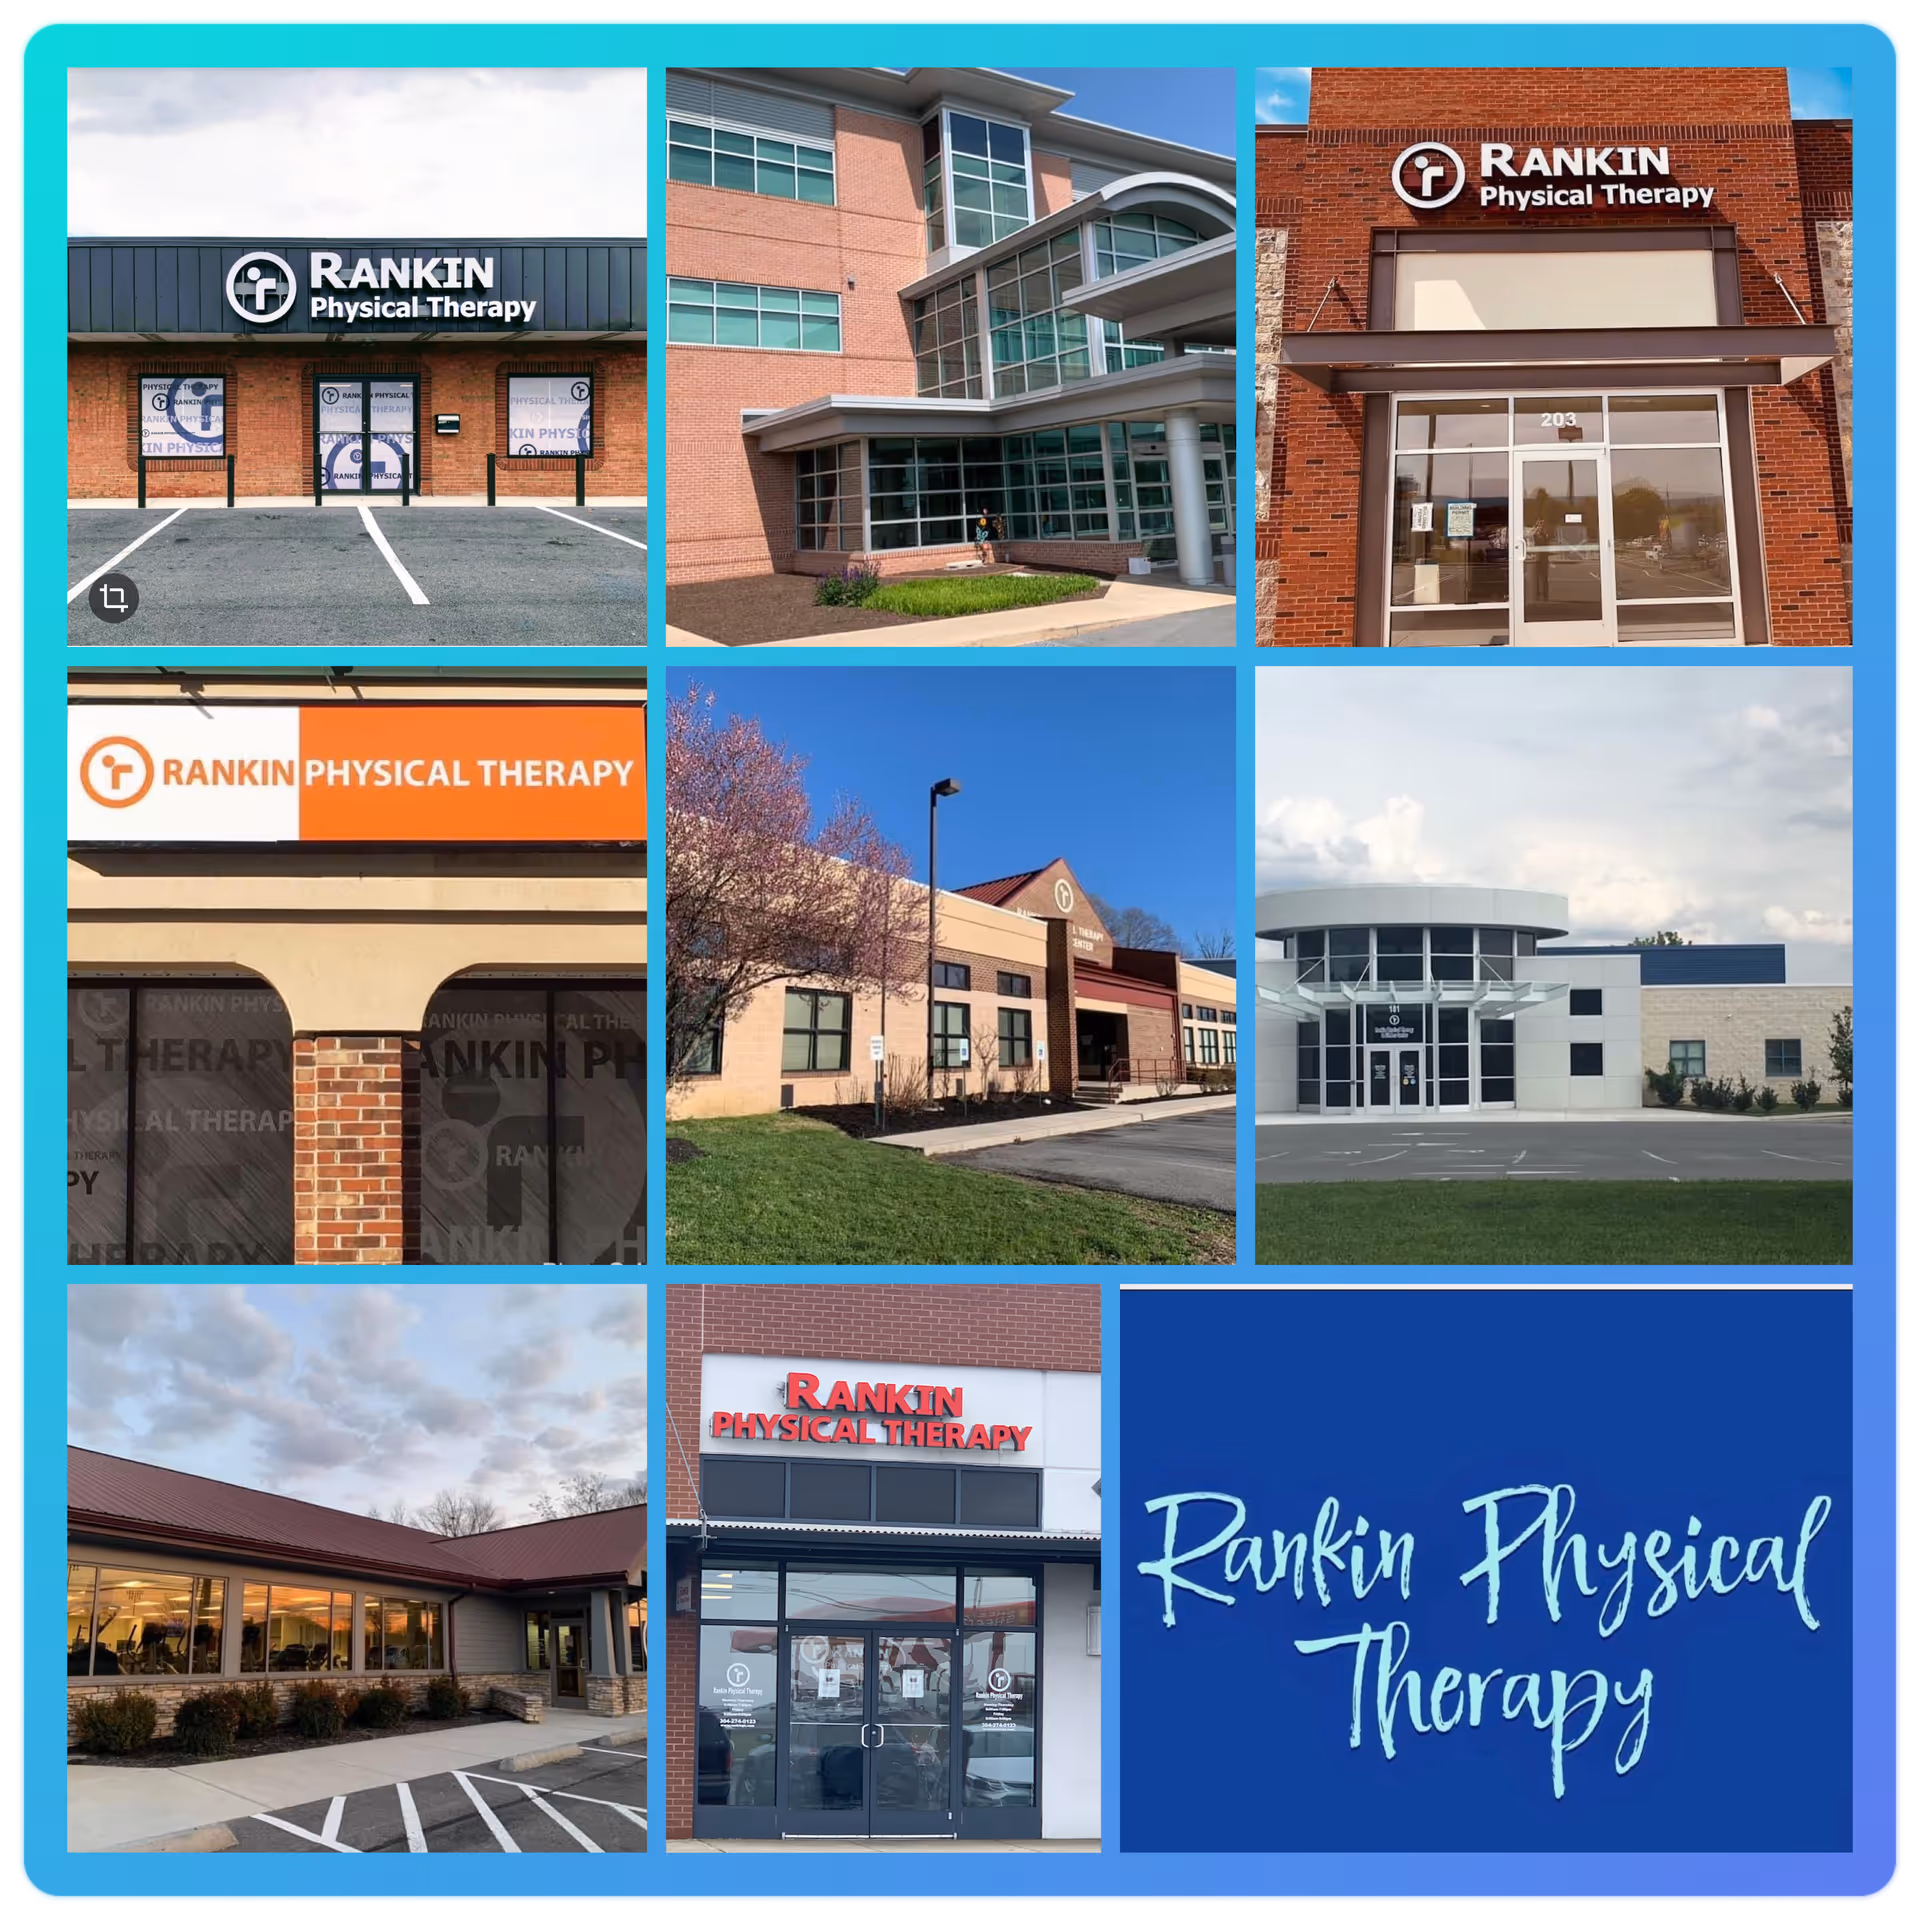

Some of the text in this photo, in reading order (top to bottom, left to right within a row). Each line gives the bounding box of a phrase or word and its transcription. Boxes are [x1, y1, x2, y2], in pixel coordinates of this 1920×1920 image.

[1481, 143, 1669, 178] RANKIN
[1481, 183, 1714, 211] Physical Therapy
[311, 251, 494, 289] RANKIN
[311, 296, 537, 323] Physical Therapy
[1541, 412, 1577, 426] 203
[162, 758, 635, 787] RANKIN PHYSICAL THERAPY
[787, 1371, 964, 1418] RANKIN
[711, 1411, 1033, 1451] PHYSICAL THERAPY
